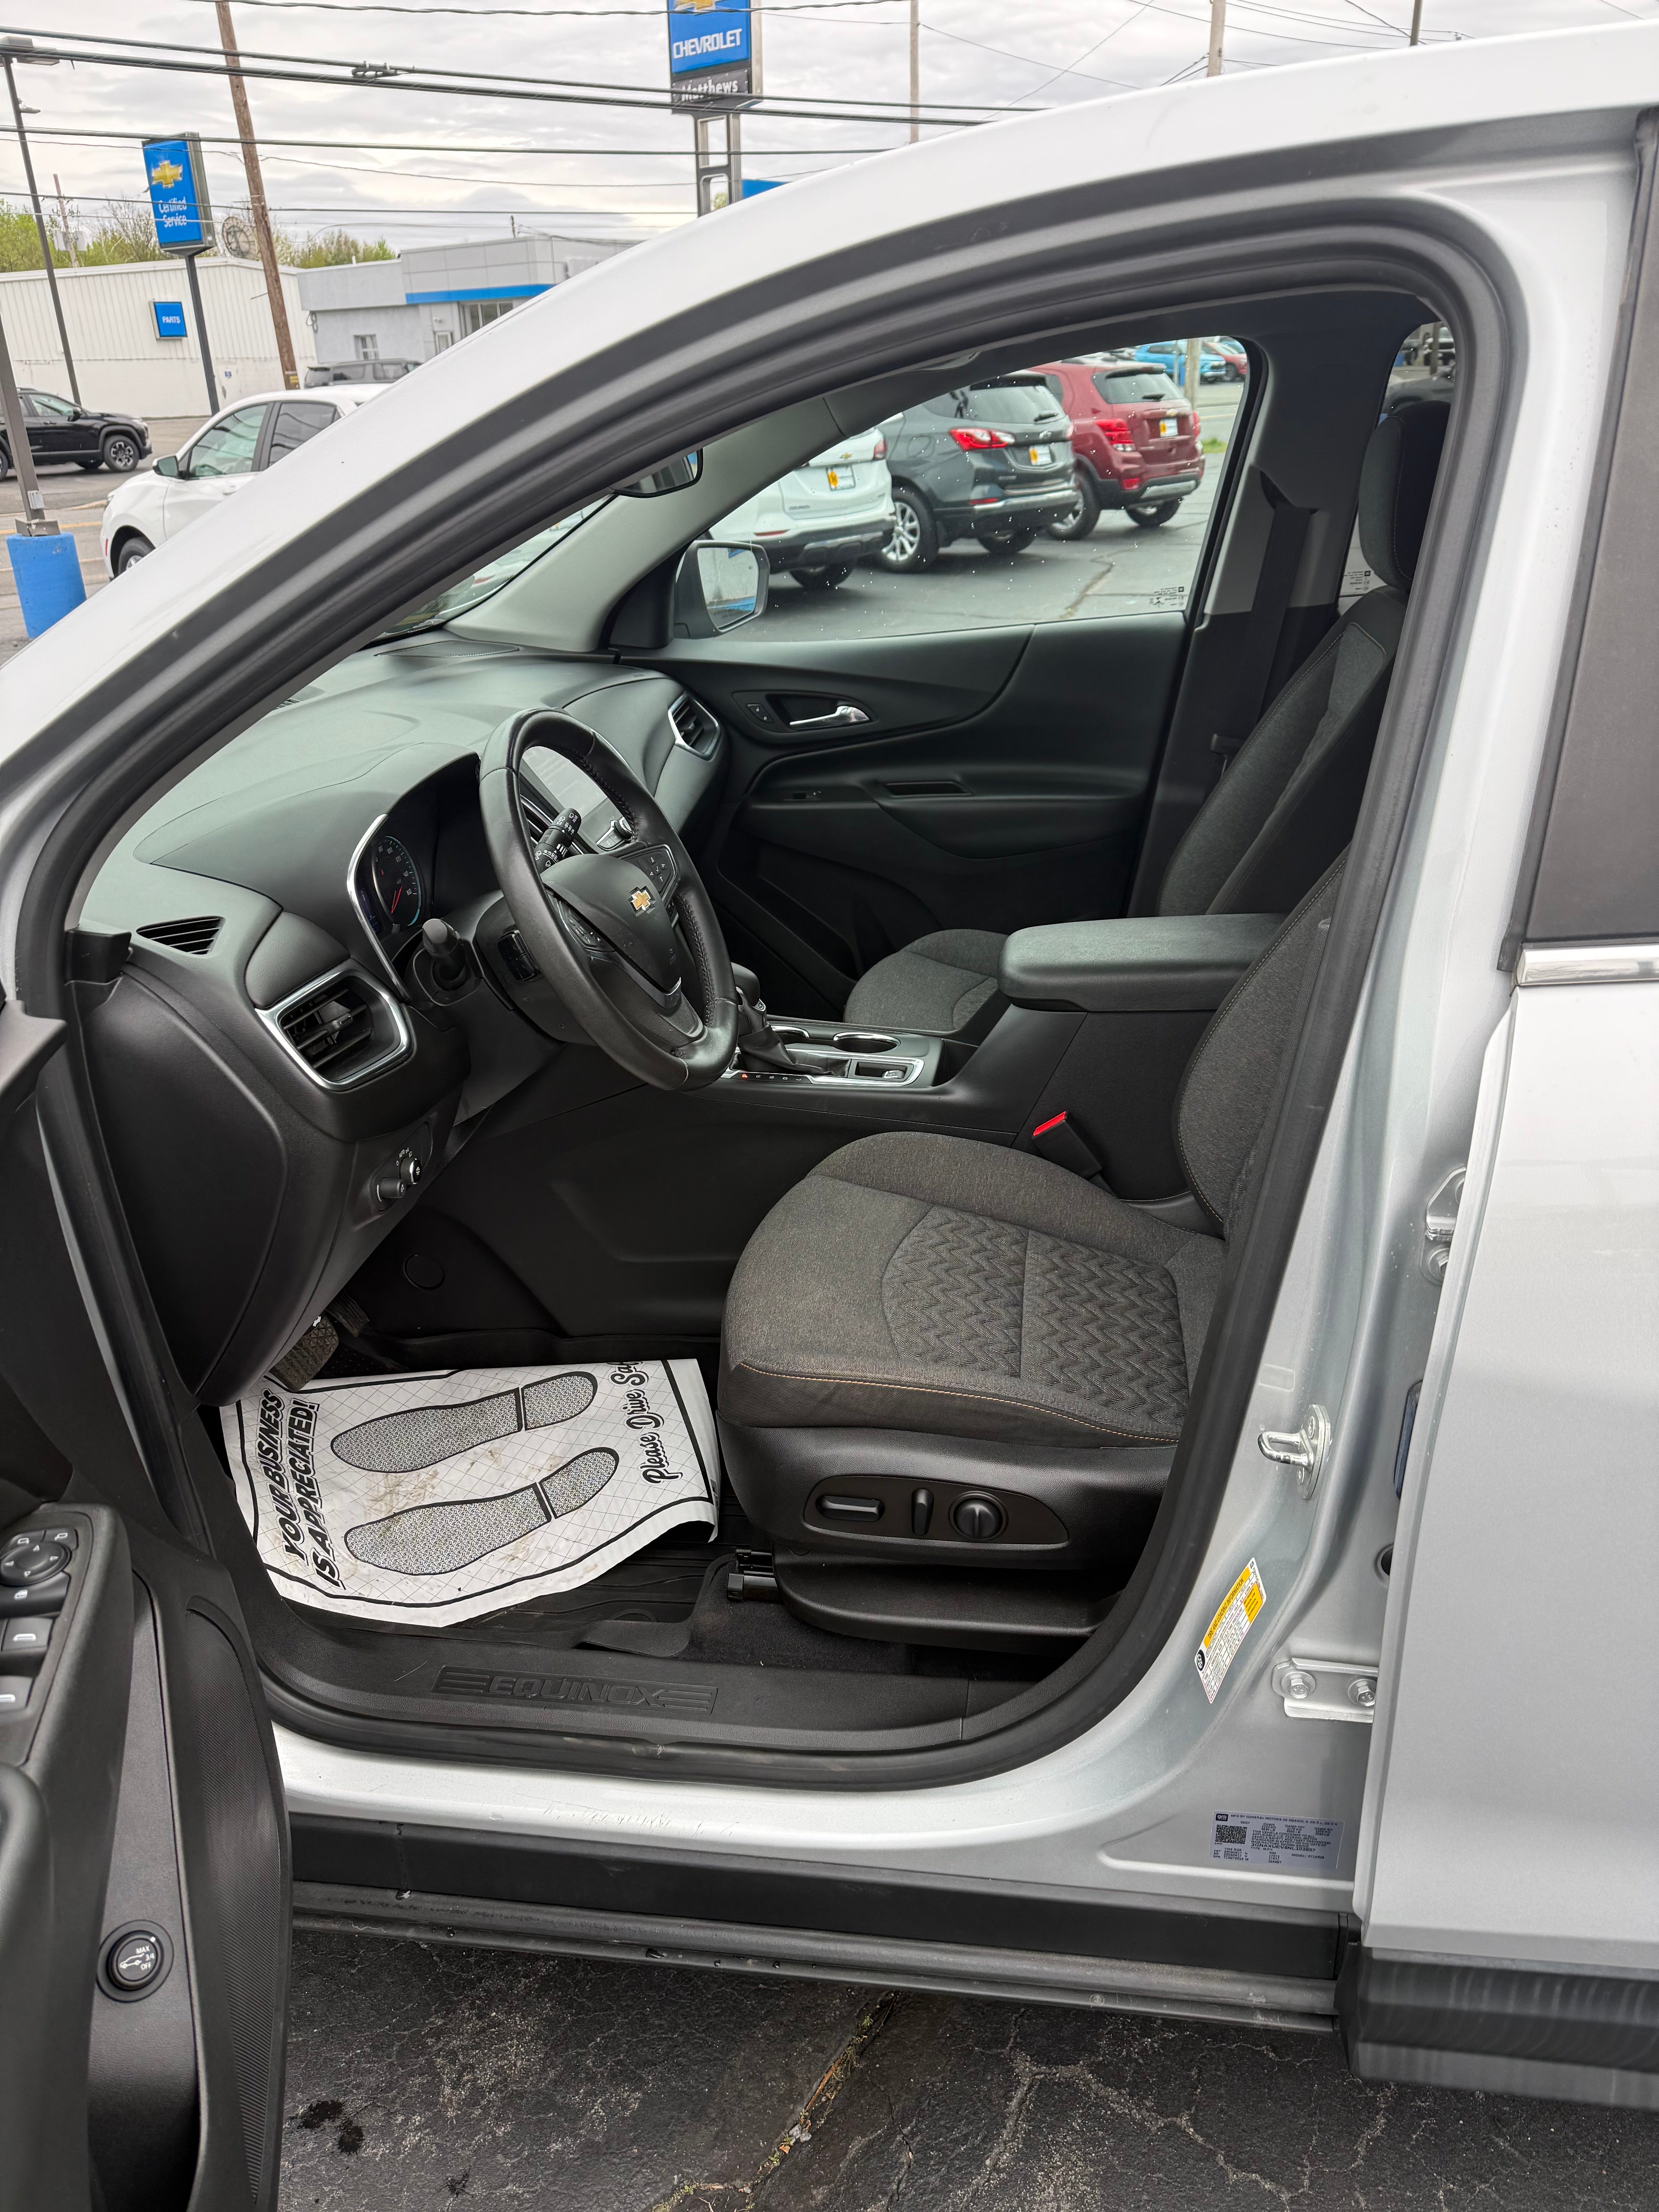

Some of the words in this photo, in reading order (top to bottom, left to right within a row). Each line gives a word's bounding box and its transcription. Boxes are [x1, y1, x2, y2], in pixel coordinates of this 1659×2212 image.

[673, 28, 742, 59] CHEVROLET
[681, 79, 738, 101] Matthews
[159, 196, 187, 213] Certified
[163, 213, 187, 228] Service
[162, 316, 181, 324] PARTS
[622, 1389, 663, 1430] Drive
[256, 1389, 289, 1490] BUSINESS
[640, 1432, 682, 1484] Please
[287, 1398, 335, 1562] APPRECIATED!
[271, 1484, 308, 1565] YOUR
[311, 1547, 346, 1590] IS
[1216, 1601, 1228, 1623] LOADING
[1226, 1576, 1243, 1606] INFORMATION
[1232, 1606, 1242, 1625] PRESSURE
[488, 1675, 665, 1707] EQUINOX
[136, 1945, 150, 1954] MAX
[140, 1962, 151, 1970] OFF
